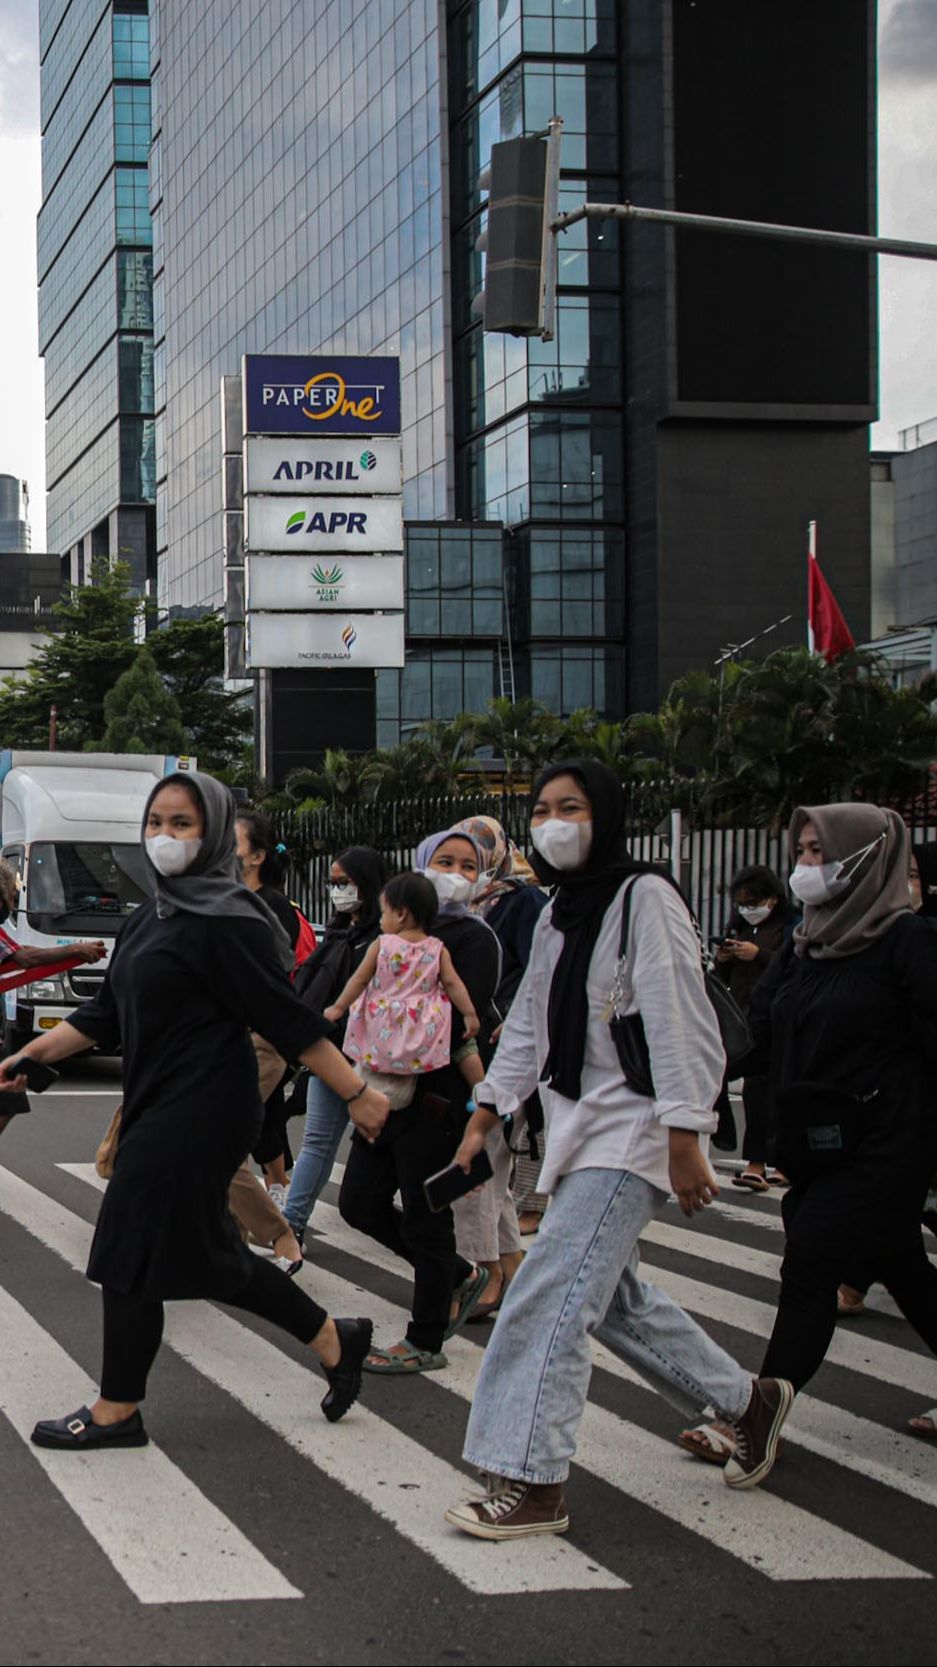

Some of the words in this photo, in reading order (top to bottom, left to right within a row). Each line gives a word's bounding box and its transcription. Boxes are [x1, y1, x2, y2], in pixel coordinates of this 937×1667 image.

[264, 389, 338, 406] PAPER
[272, 461, 359, 480] APRIL
[306, 512, 367, 534] APR
